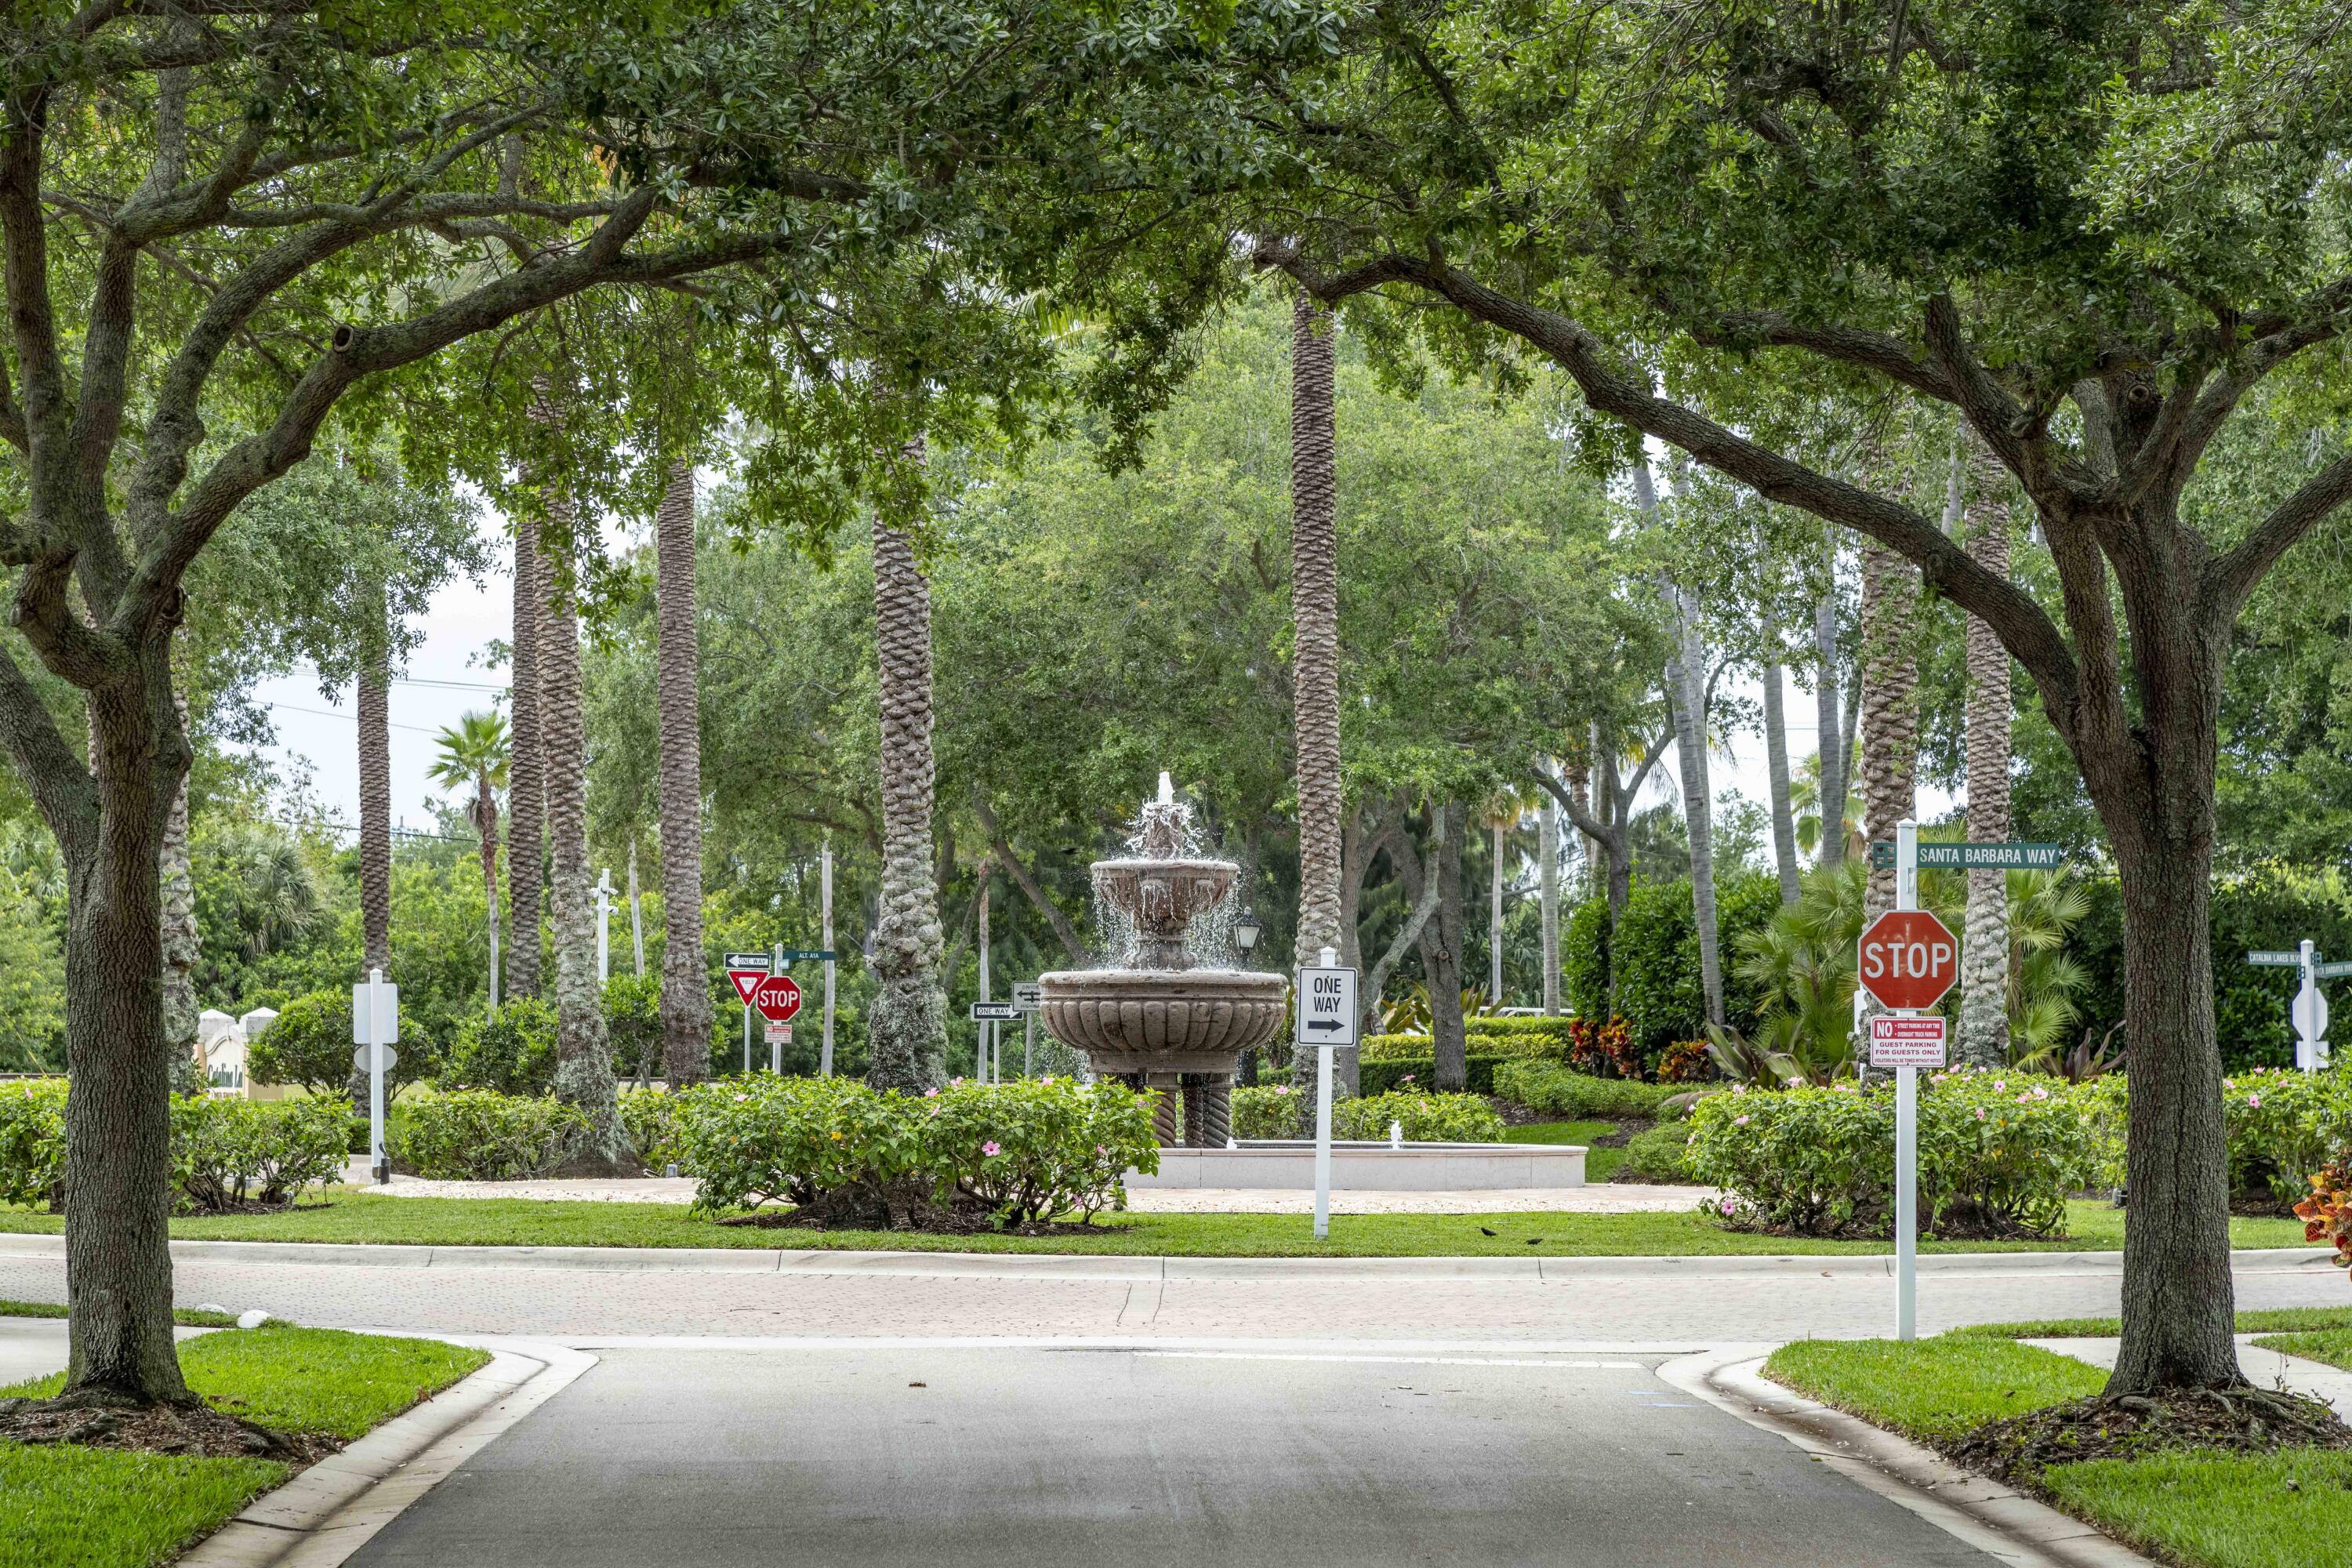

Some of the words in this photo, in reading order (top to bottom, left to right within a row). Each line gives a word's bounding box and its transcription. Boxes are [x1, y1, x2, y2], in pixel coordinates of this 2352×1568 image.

[1920, 848, 1959, 862] SANTA
[1965, 848, 2022, 863] BARBARA
[2027, 849, 2056, 863] WAY
[1864, 942, 1951, 978] STOP
[2249, 953, 2272, 963] CATALINA
[2274, 953, 2289, 963] LAKES
[1314, 977, 1341, 994] ONE
[760, 989, 798, 1007] STOP
[1314, 996, 1341, 1013] WAY
[1876, 1022, 1893, 1038] NO
